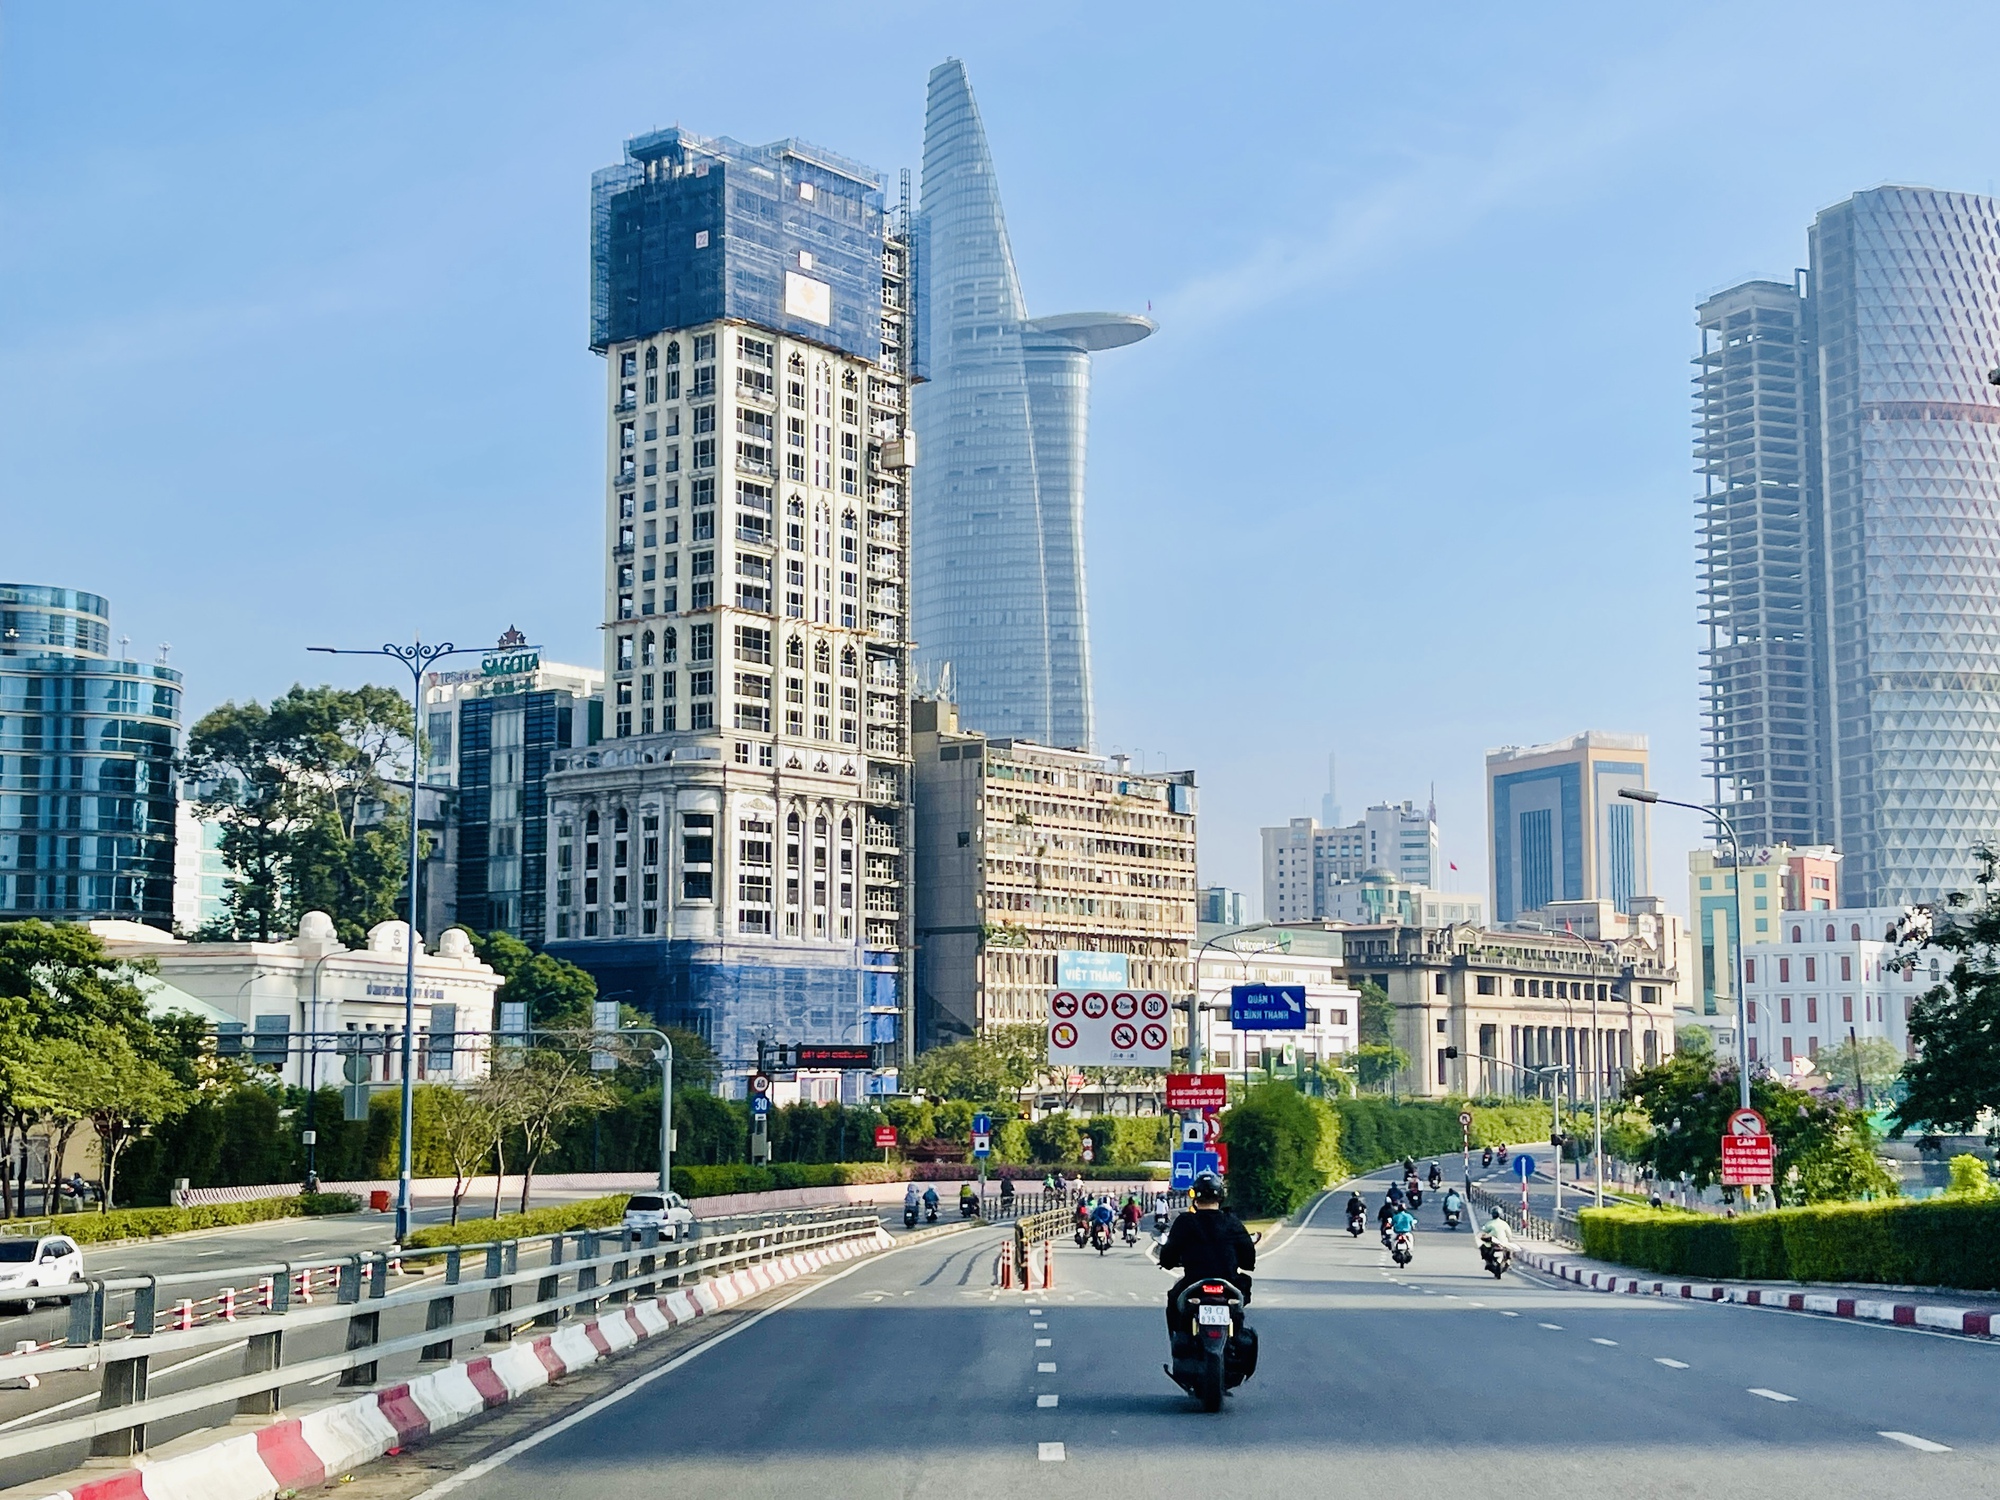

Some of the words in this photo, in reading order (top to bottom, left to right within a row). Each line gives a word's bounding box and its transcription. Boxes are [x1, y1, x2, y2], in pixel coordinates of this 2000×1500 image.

[1065, 967, 1088, 983] VIỆT
[1270, 994, 1275, 1004] 1
[755, 1098, 767, 1111] 30
